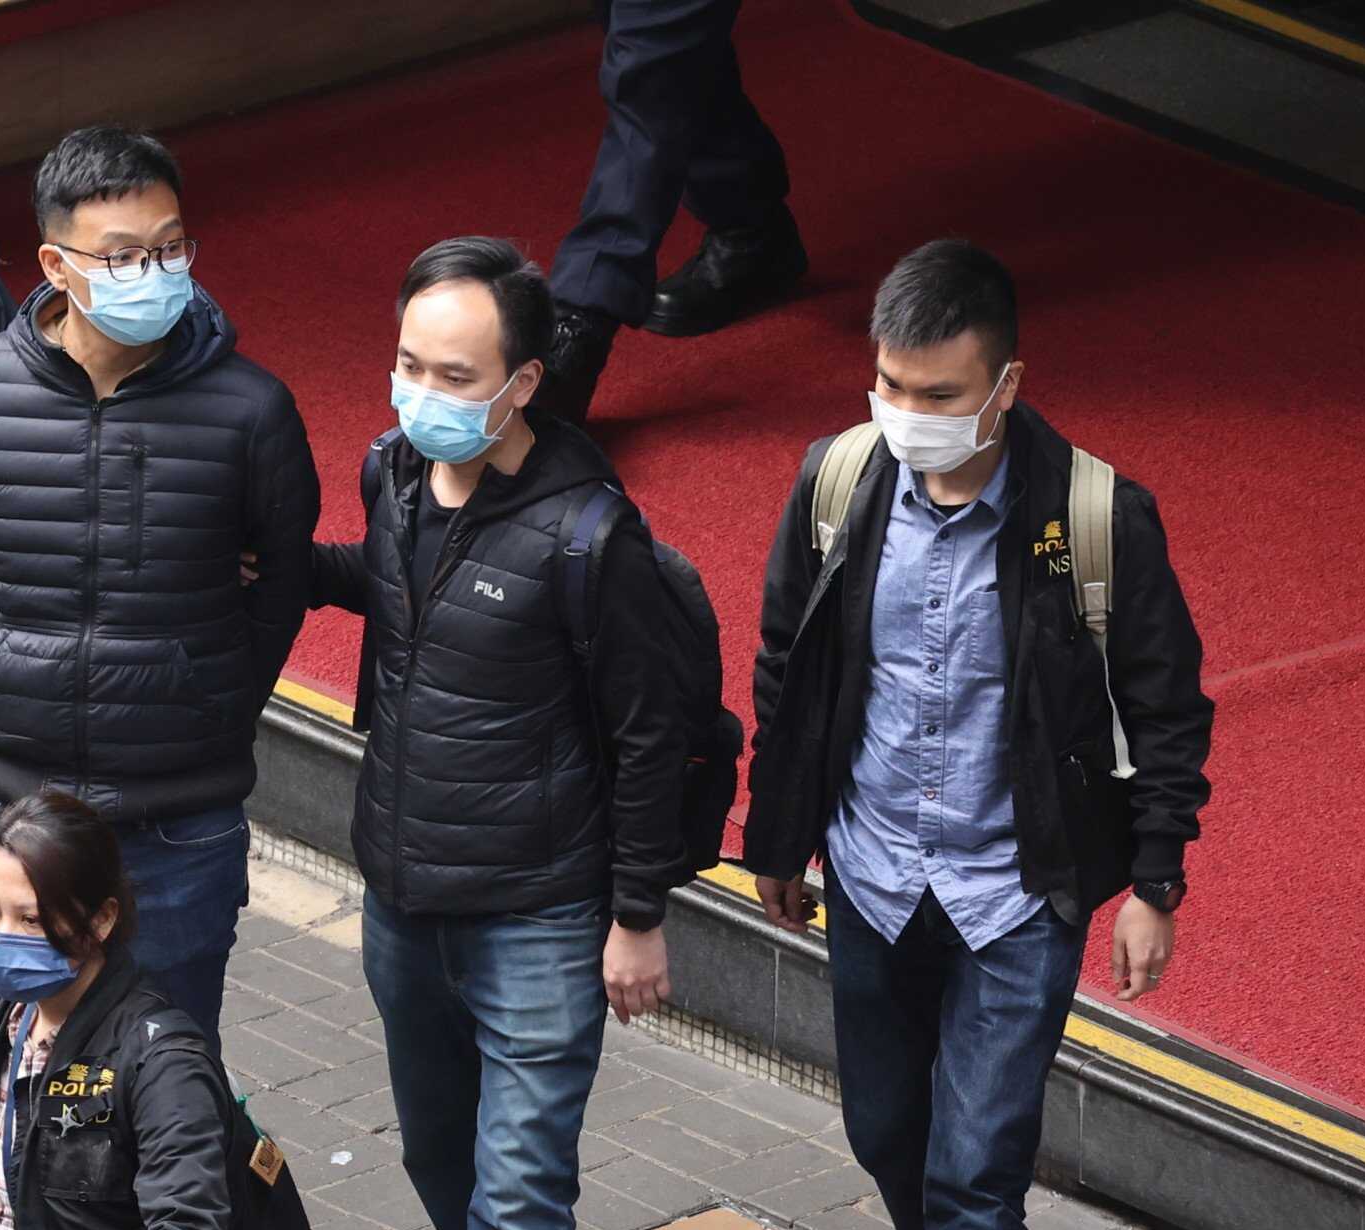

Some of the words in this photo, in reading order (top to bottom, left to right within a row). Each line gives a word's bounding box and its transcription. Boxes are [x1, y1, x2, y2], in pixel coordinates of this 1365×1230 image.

[1034, 539, 1067, 556] POL
[1049, 555, 1071, 576] NS
[474, 580, 504, 601] FILA
